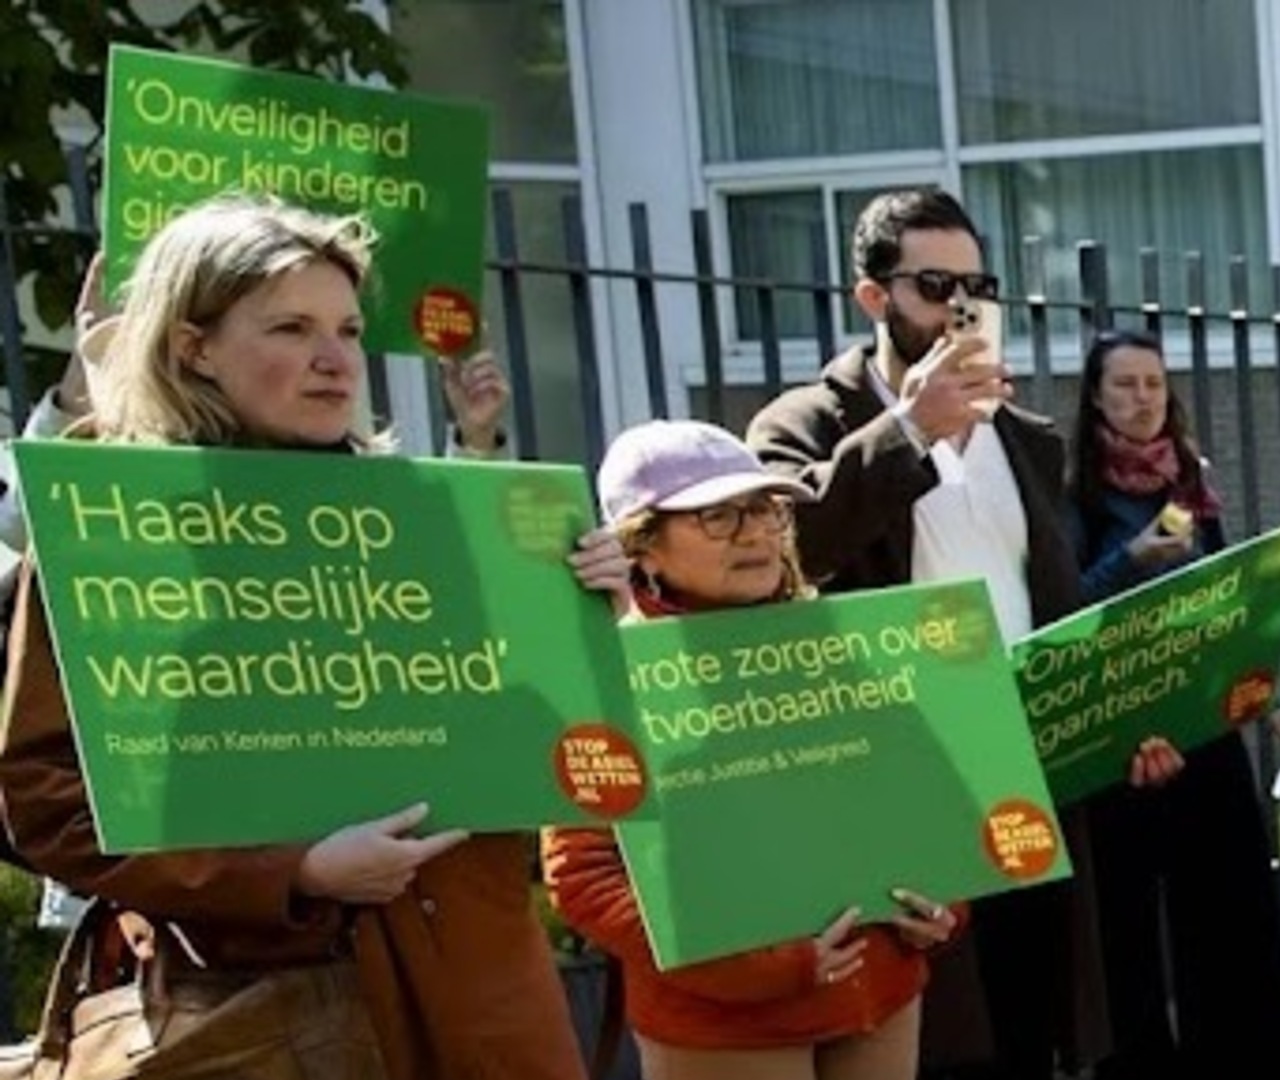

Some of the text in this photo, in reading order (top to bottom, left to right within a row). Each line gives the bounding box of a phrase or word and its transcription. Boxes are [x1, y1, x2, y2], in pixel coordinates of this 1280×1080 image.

[126, 78, 410, 159] 'Onveiligheid
[124, 144, 427, 211] voor kinderen
[50, 482, 394, 562] 'Haaks op
[73, 564, 432, 635] menselijke
[85, 639, 507, 710] waardigheid'
[629, 616, 957, 692] rote zorgen over
[1028, 605, 1248, 717] oor kinderen
[640, 664, 917, 744] tvoerbaarheid'
[105, 726, 447, 755] Raad van Kerken in Nederland
[562, 738, 608, 756] STOP
[569, 770, 642, 786] WETTEN
